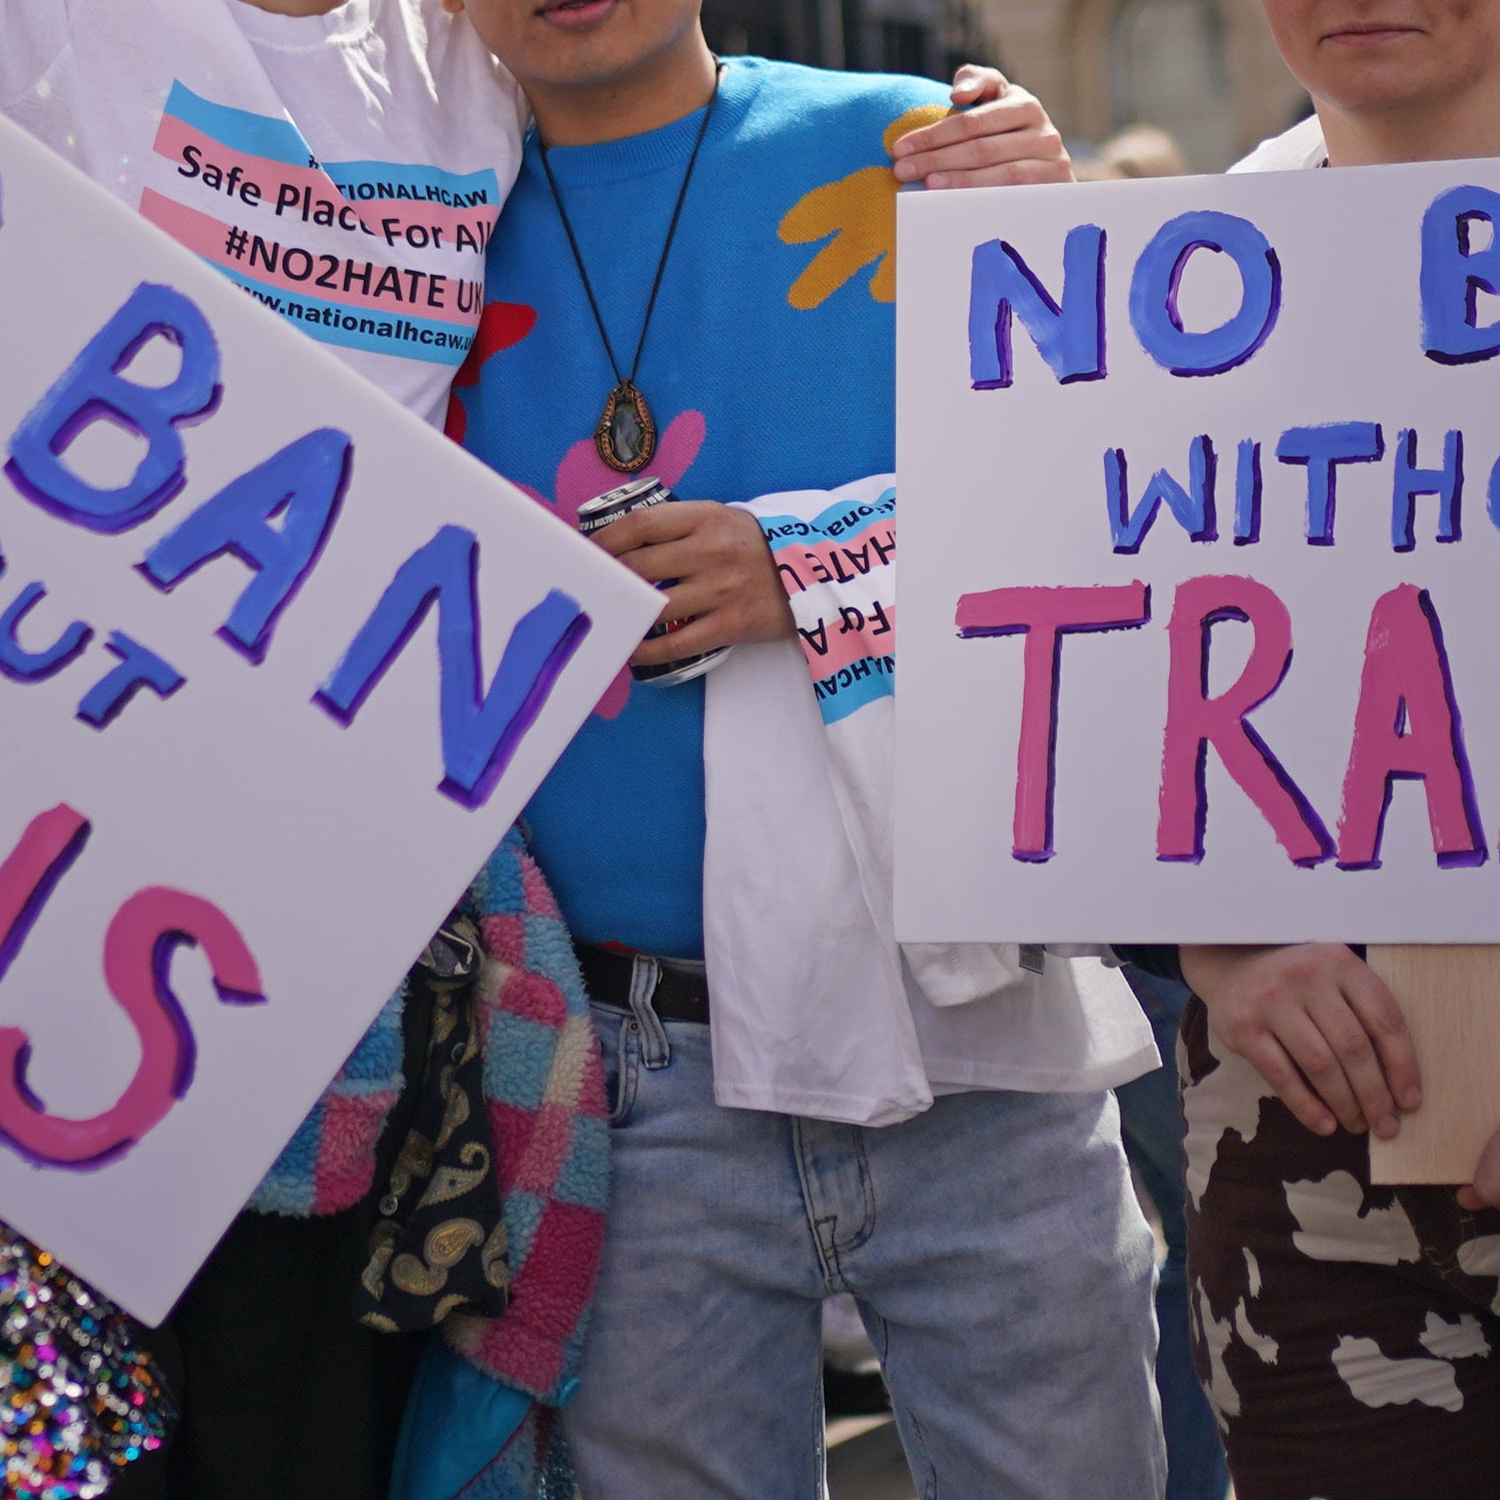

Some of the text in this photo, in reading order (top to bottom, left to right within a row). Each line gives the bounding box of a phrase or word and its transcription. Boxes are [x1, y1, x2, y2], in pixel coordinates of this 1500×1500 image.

[177, 145, 262, 207] Safe
[381, 217, 445, 249] For
[225, 225, 447, 308] #NO2HATE
[969, 211, 1282, 390] NO
[4, 282, 591, 806] BAN
